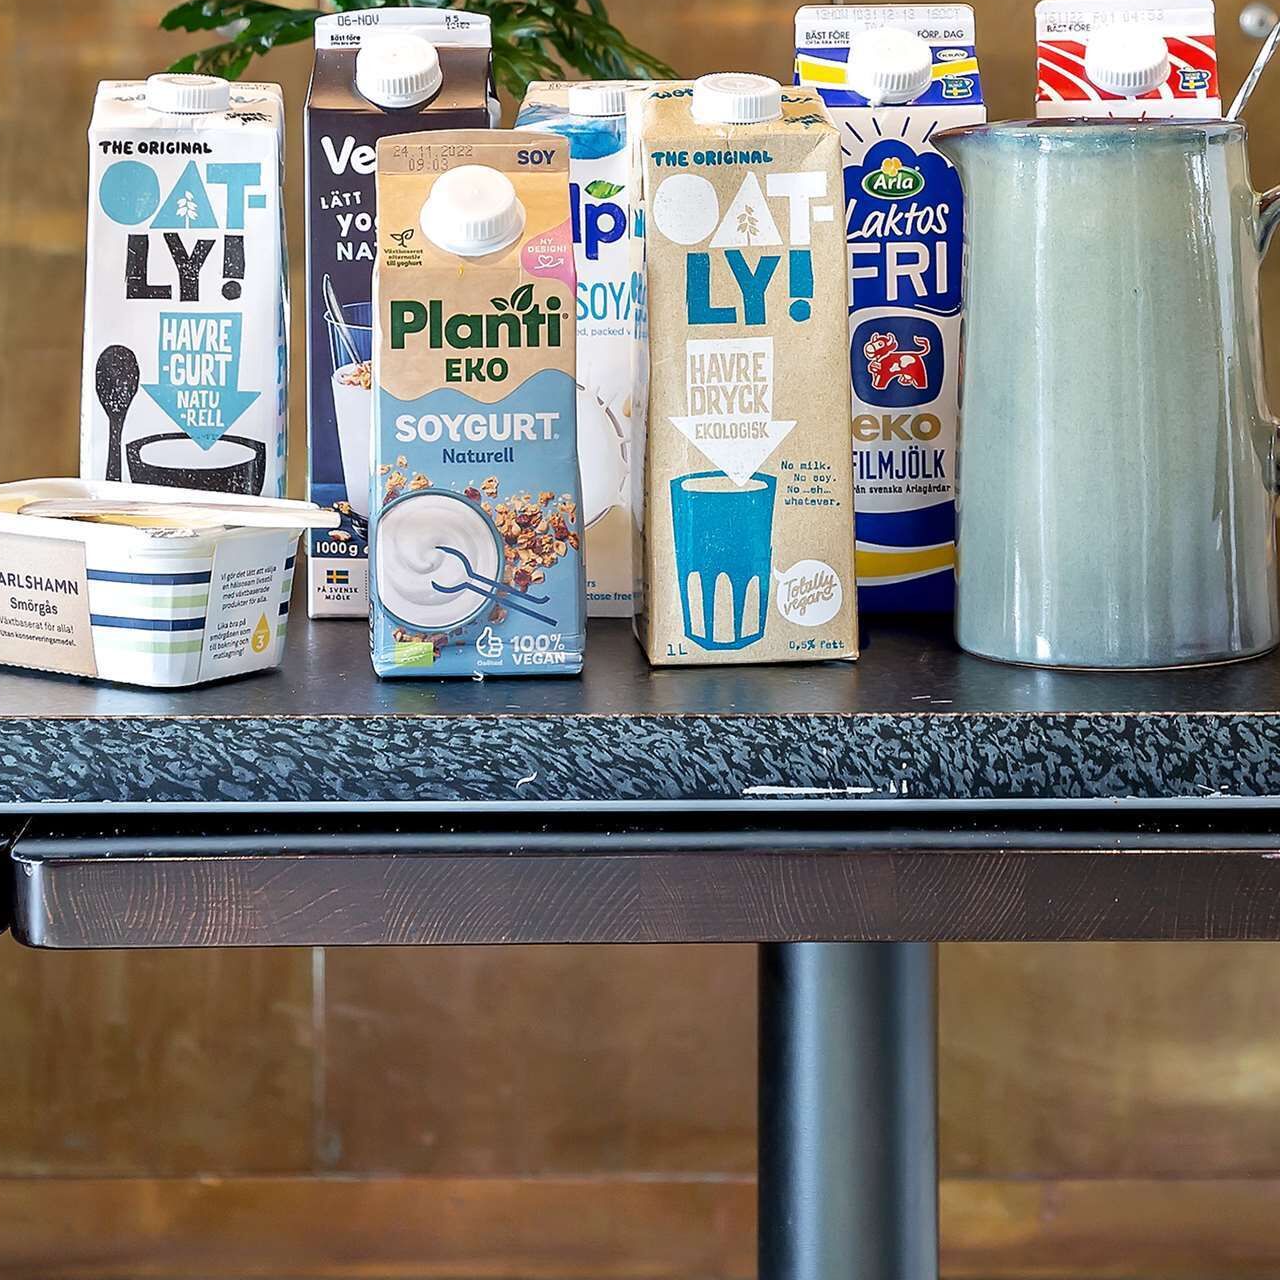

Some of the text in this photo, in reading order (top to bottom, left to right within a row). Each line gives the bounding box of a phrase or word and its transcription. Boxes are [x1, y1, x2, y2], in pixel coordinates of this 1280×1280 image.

[805, 30, 850, 40] BÄST FÖRE
[943, 30, 965, 39] DAG
[99, 141, 213, 155] THE ORIGINAL
[516, 150, 556, 165] SOY
[651, 150, 773, 167] THE ORIGINAL
[873, 174, 914, 191] Arla
[320, 190, 361, 209] LÄTT
[336, 212, 377, 237] yo
[846, 198, 949, 240] Laktos
[337, 242, 377, 261] NA
[125, 232, 247, 302] LY!
[847, 241, 948, 307] FRI
[686, 249, 814, 325] LY!
[390, 295, 562, 350] Planti
[162, 319, 233, 353] HAVRE
[591, 327, 625, 338] packed
[444, 357, 509, 383] EKO
[690, 352, 767, 385] HAVRE
[177, 390, 220, 409] NATU
[690, 384, 770, 417] DRYCK
[695, 422, 770, 440] EKOLOGISK
[852, 412, 942, 443] eko
[442, 447, 515, 465] Naturell
[781, 461, 831, 470] No milk.
[794, 473, 836, 484] No soy.
[787, 485, 800, 494] No
[869, 485, 903, 494] svenska
[784, 497, 840, 506] whatever.
[784, 570, 838, 602] Totally
[325, 593, 352, 601] MJÖLK
[784, 590, 834, 616] vegan
[10, 597, 58, 617] Smörgås
[0, 615, 44, 630] Växtbaserat
[44, 622, 56, 632] för
[0, 629, 15, 638] Utan
[510, 633, 565, 652] 100%
[789, 638, 816, 651] 0,5%
[512, 652, 566, 665] VEGAN
